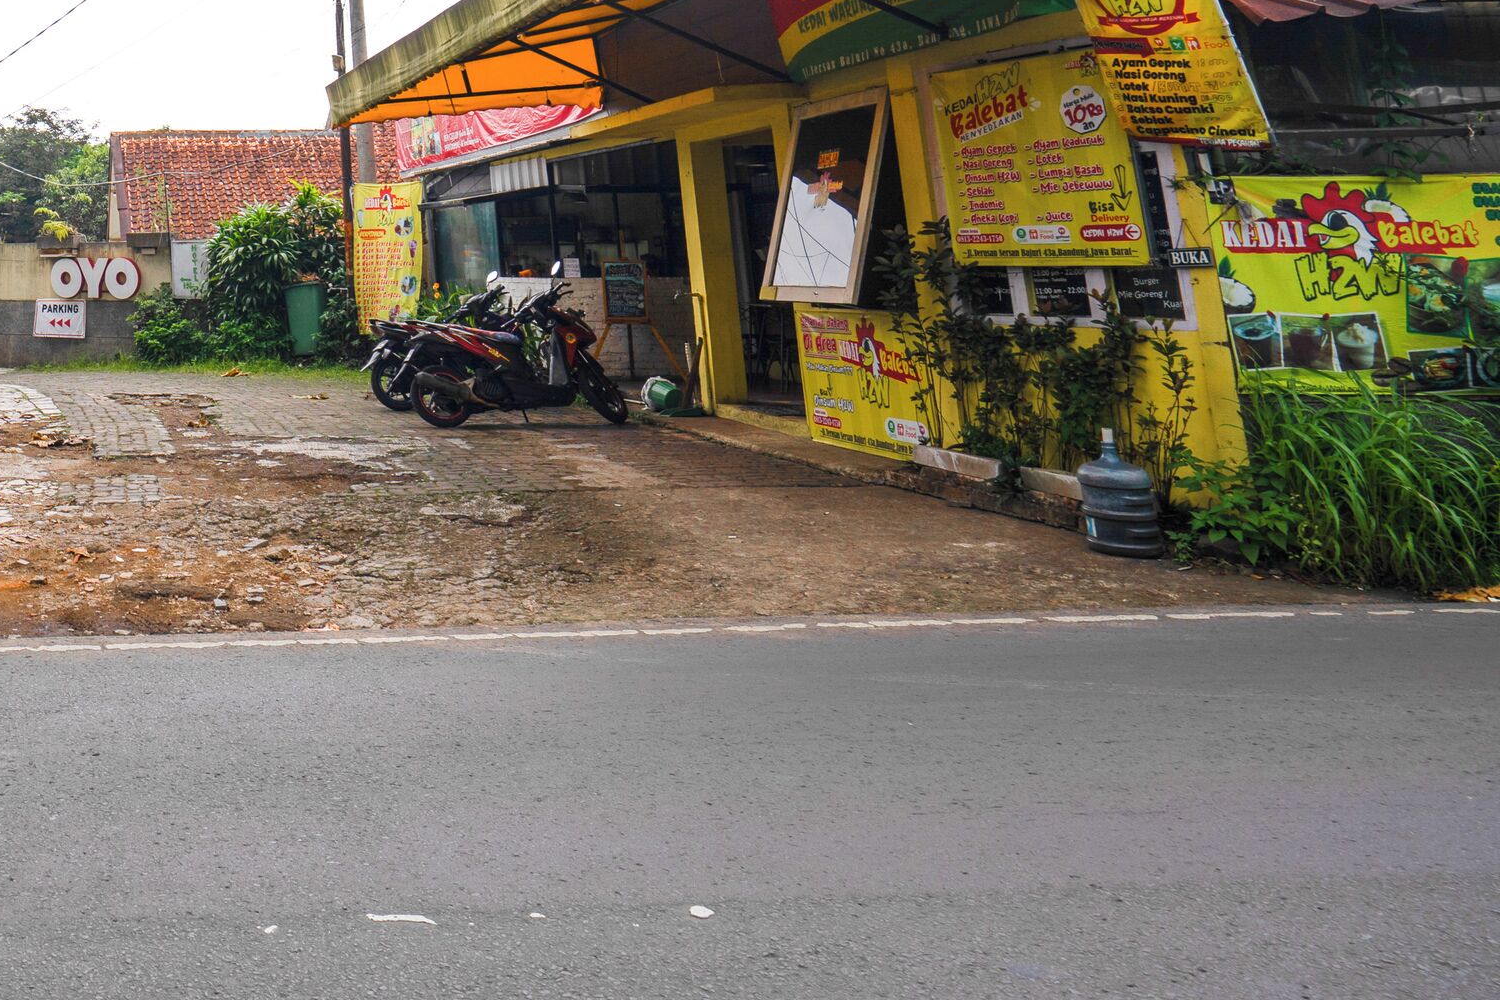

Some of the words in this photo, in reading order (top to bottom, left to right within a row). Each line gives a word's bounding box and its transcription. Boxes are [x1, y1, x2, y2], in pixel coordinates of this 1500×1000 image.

[1203, 40, 1230, 50] Food
[1111, 58, 1147, 71] Ayam
[1149, 58, 1191, 71] Geprek
[1114, 70, 1141, 80] Nasi
[1143, 70, 1186, 83] Goreng
[1117, 81, 1150, 92] Lotek
[944, 93, 978, 116] KEDAI
[1123, 92, 1147, 103] Nasi
[1149, 93, 1198, 106] Kuning
[950, 84, 1029, 140] Balebat
[1126, 103, 1162, 115] Bakso
[1163, 103, 1215, 115] Cuanki
[1082, 121, 1095, 131] an
[1130, 115, 1174, 125] Seblak
[960, 111, 1023, 143] MENYEDIAKAN
[1208, 125, 1256, 138] Cincau
[961, 146, 984, 159] Ayam
[986, 143, 1017, 157] Geprek
[1033, 139, 1060, 153] Ayam
[962, 161, 981, 171] Nasi
[982, 158, 1013, 170] Goreng
[1035, 153, 1064, 165] Lotek
[1037, 167, 1073, 181] Lumpia
[1039, 183, 1060, 194] Mie
[969, 200, 1005, 211] Indomie
[1088, 200, 1115, 214] Bisa
[1044, 211, 1074, 222] Juice
[1090, 213, 1130, 223] Delivery
[1220, 219, 1307, 248] KEDAI
[1377, 218, 1481, 248] Balebat
[1171, 250, 1209, 265] BUKA
[50, 257, 141, 300] OYO
[1133, 277, 1160, 287] Burger
[1293, 251, 1404, 302] H2W
[1118, 290, 1133, 299] Mie
[1134, 289, 1162, 300] Goreng
[41, 304, 79, 314] PARKING
